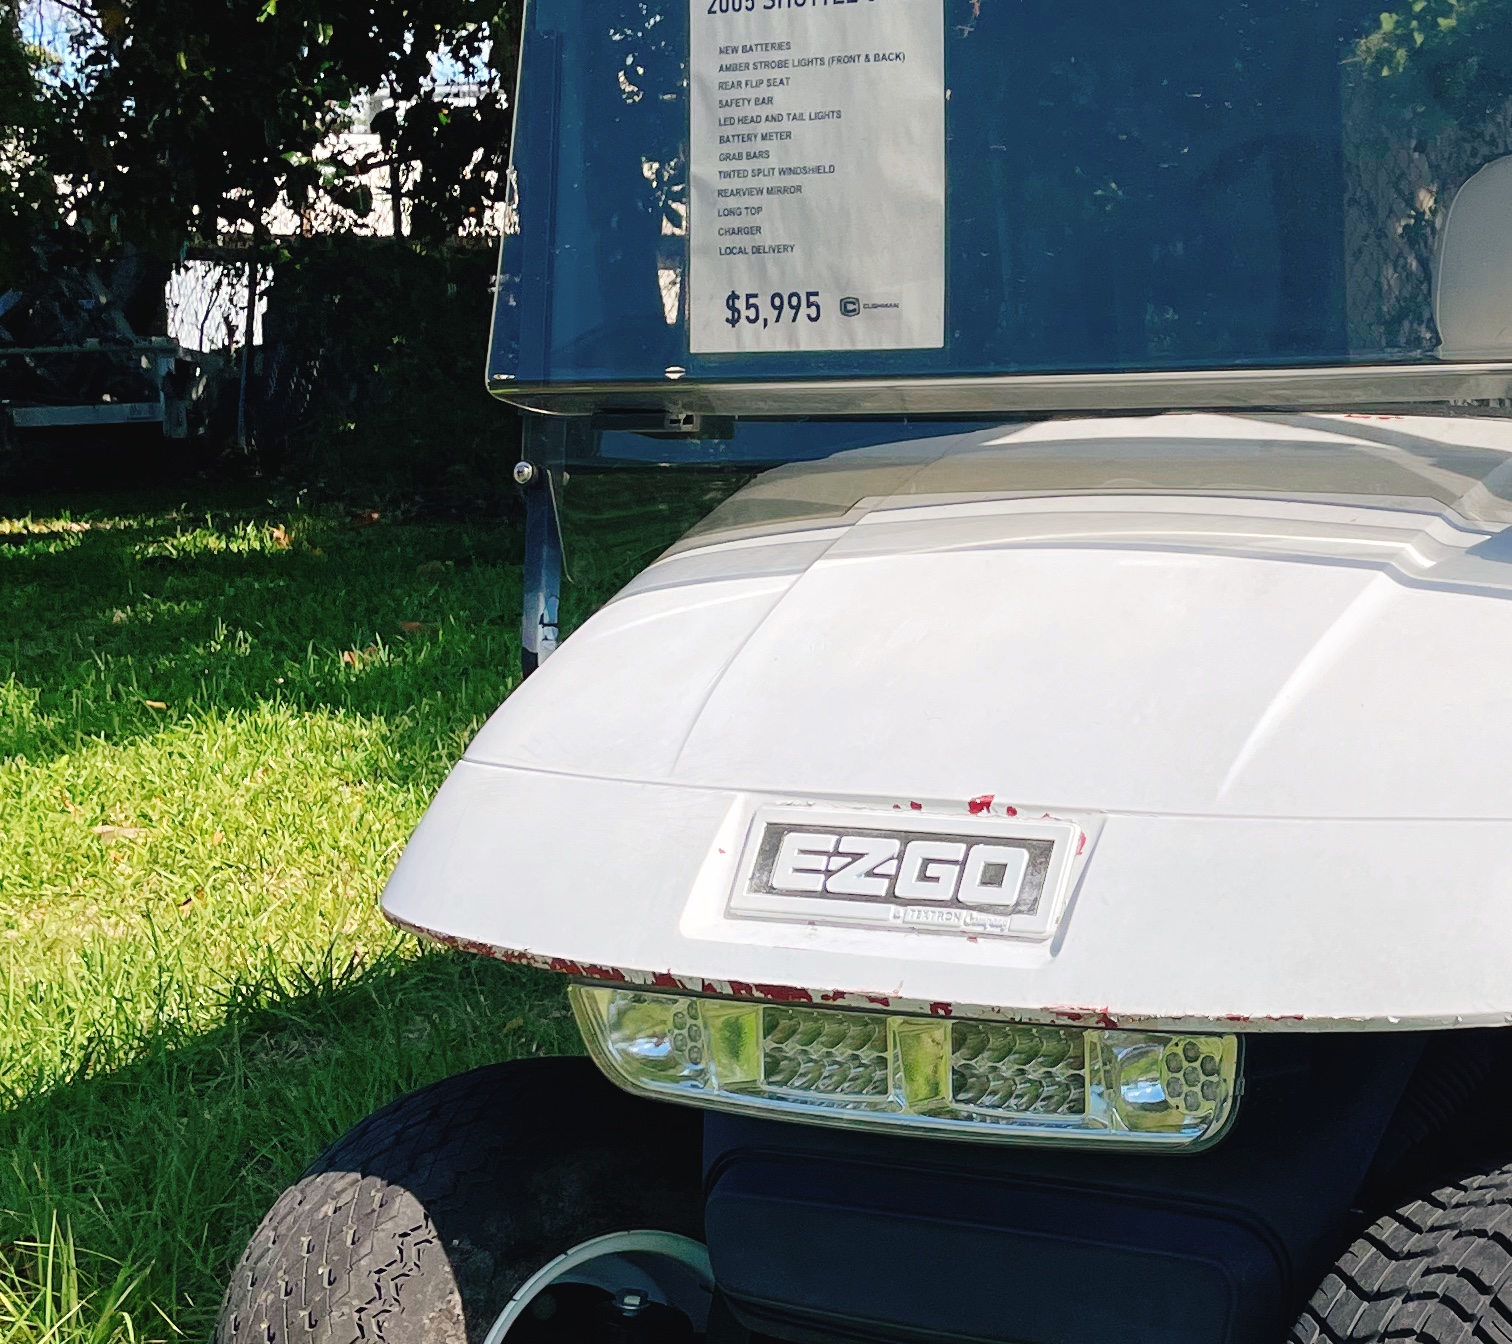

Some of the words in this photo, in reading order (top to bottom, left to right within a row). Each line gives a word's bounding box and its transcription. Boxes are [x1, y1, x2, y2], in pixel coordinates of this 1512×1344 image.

[718, 44, 739, 55] NEW
[741, 41, 792, 54] BATTERIES
[718, 59, 750, 73] AMBER
[752, 58, 790, 71] STROBE
[792, 57, 826, 69] LIGHTS
[828, 54, 861, 68] (FRONT
[864, 54, 871, 64] &
[873, 51, 906, 64] BACK)
[717, 79, 743, 91] REAR
[745, 78, 764, 90] FLIP
[766, 76, 791, 88] SEAT
[718, 97, 752, 109] SAFETY
[754, 96, 774, 106] BAR
[718, 116, 736, 127] LED
[737, 114, 762, 126] HEAD
[764, 112, 784, 124] AND
[786, 111, 806, 122] TAIL
[808, 109, 842, 122] LIGHTS
[719, 132, 759, 145] BATTERY
[761, 131, 792, 142] METER
[718, 151, 744, 162] GRAB
[746, 150, 770, 160] BARS
[718, 169, 749, 180] TINTED
[751, 166, 776, 178] SPLIT
[778, 164, 836, 176] WINDSHIELD
[717, 186, 764, 198] REARVIEW
[766, 185, 803, 196] MIRROR
[717, 207, 743, 217] LONG
[744, 206, 763, 216] TOP
[717, 225, 762, 237] CHARGER
[718, 245, 750, 256] LOCAL
[751, 243, 795, 255] DELIVERY
[725, 290, 821, 329] $5,995
[770, 830, 1031, 908] EZGO
[909, 907, 962, 923] TEXTRON
